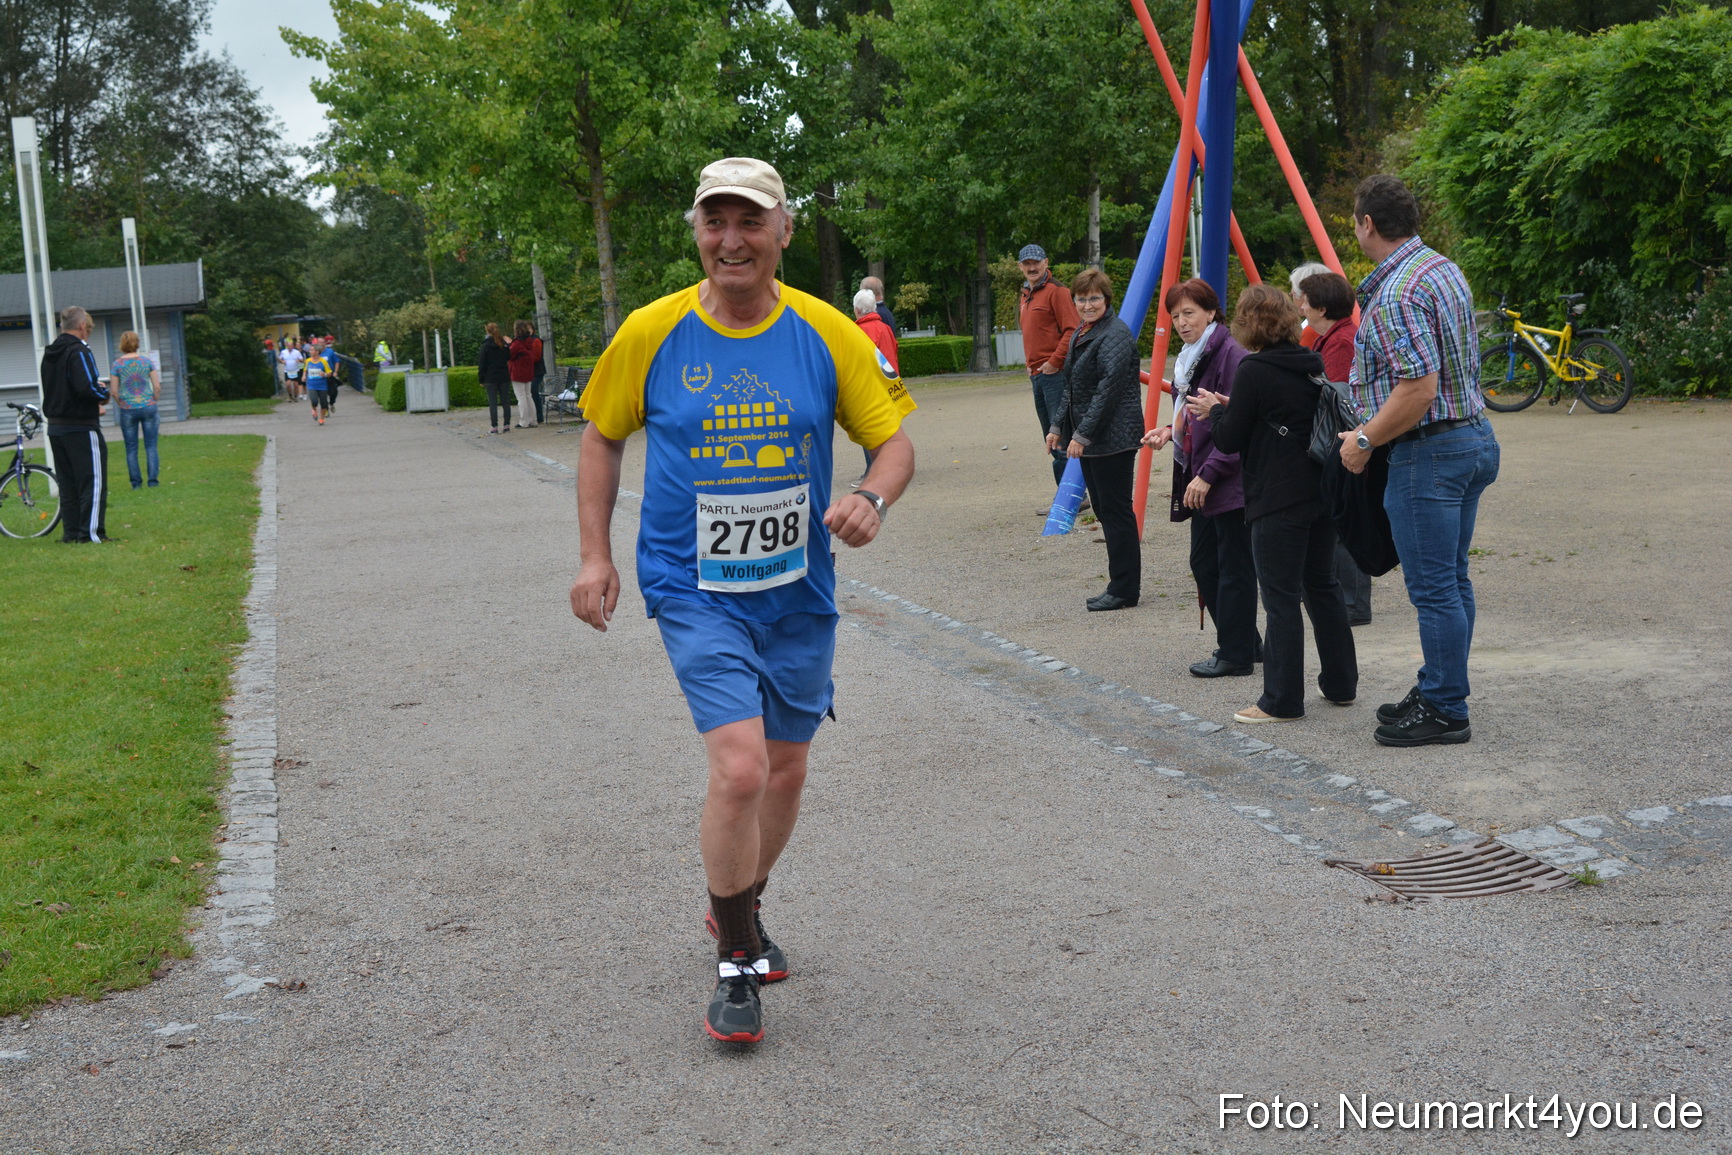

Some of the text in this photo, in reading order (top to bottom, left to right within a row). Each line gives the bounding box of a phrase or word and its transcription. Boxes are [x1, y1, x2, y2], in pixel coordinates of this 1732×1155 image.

[704, 431, 789, 443] 21.September 2014
[693, 473, 806, 486] www.stadtlauf-neumarkt.de
[700, 503, 738, 515] PARTL
[741, 499, 792, 514] Neumarkt
[709, 511, 800, 555] 2798
[721, 559, 787, 580] Wolfgang
